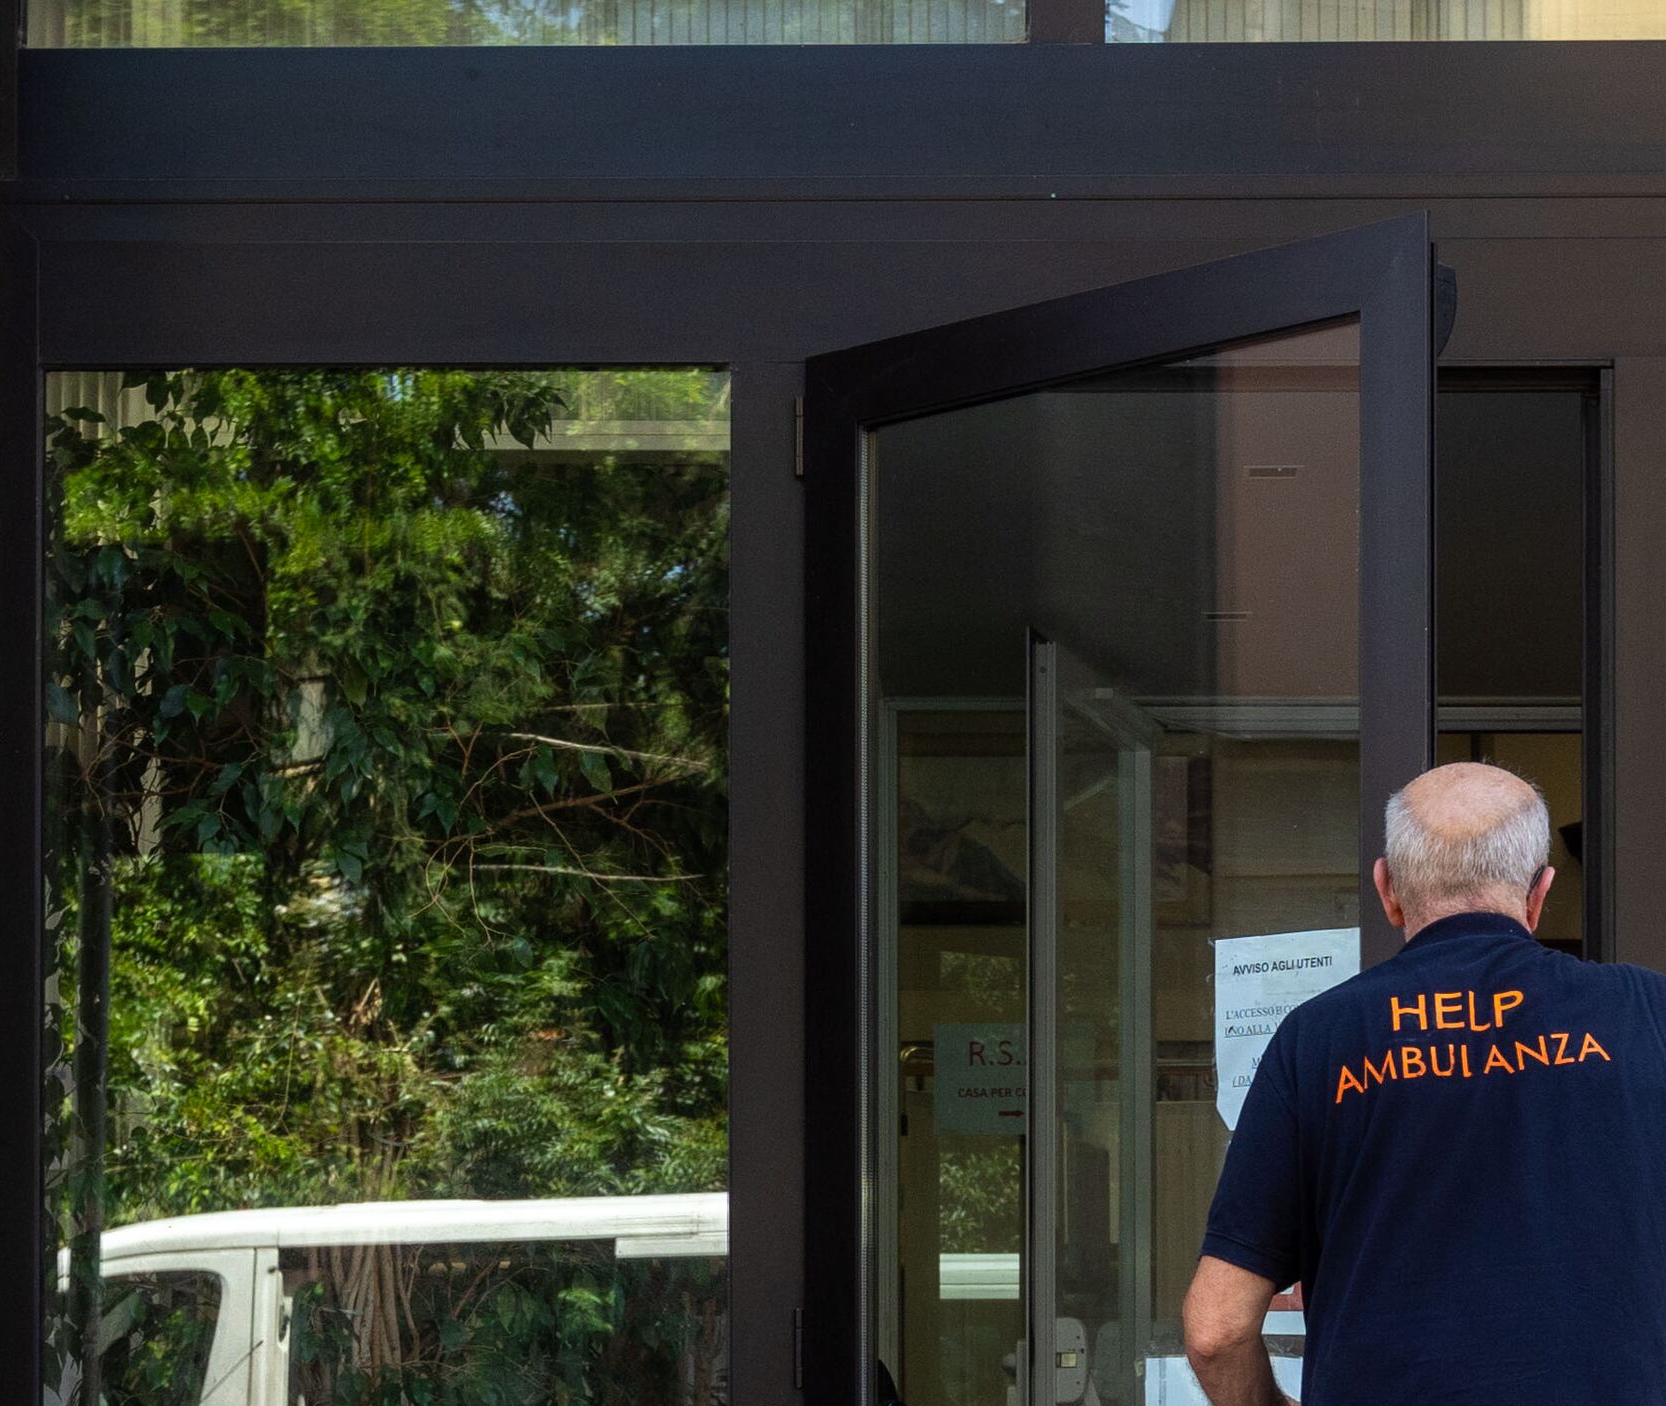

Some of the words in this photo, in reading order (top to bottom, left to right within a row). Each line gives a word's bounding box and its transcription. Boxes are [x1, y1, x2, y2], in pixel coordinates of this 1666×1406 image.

[1233, 961, 1270, 976] AVVISO
[1270, 958, 1295, 972] AGLI
[1296, 955, 1333, 970] UTENTI
[1390, 989, 1526, 1032] HELP
[968, 1039, 1026, 1067] R.S.
[957, 1087, 989, 1098] CASA
[990, 1087, 1013, 1098] PER
